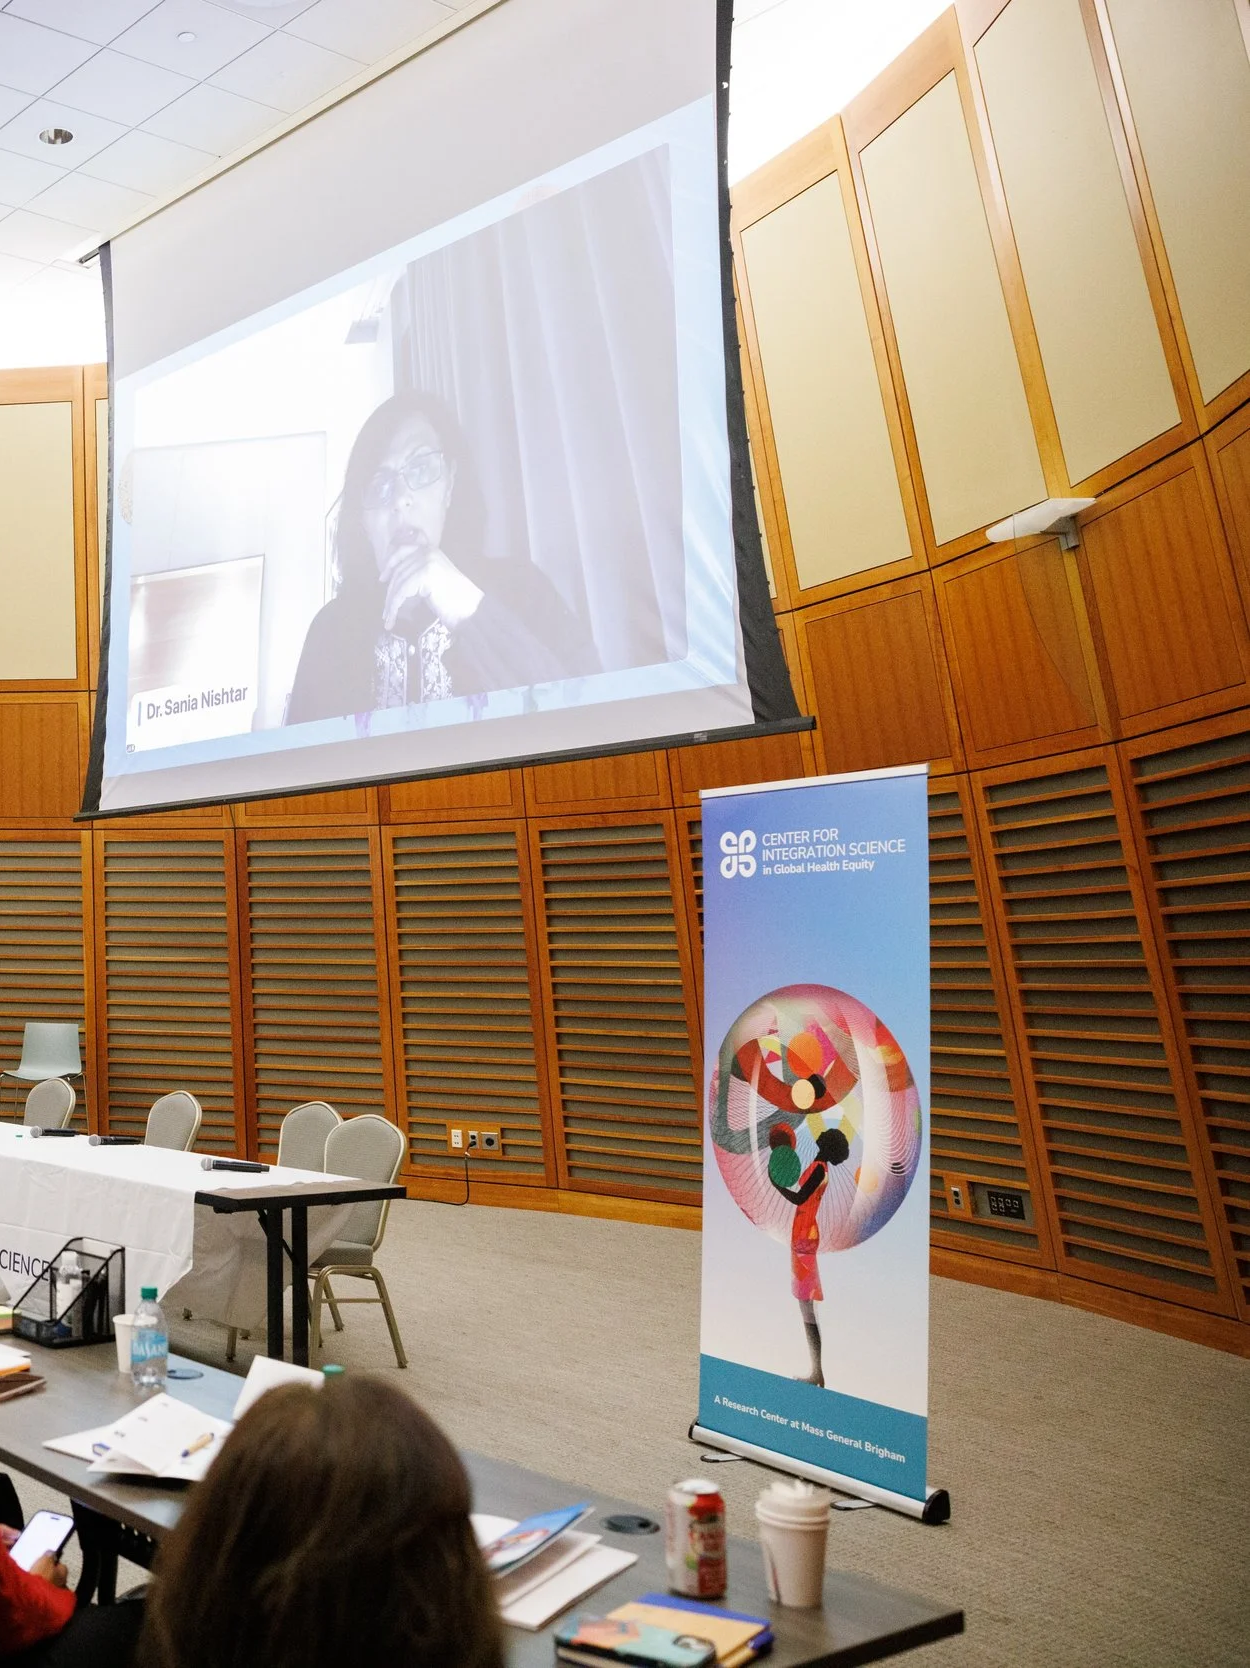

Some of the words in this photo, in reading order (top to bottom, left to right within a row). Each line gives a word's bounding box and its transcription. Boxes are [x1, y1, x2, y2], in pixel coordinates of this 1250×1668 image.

[147, 703, 162, 719] Dr.
[165, 694, 198, 716] Sania
[201, 686, 248, 709] Nishtar
[762, 831, 810, 846] CENTER
[813, 829, 838, 842] FOR
[763, 844, 845, 862] INTEGRATION
[849, 839, 905, 856] SCIENCE
[763, 865, 771, 875] in
[774, 861, 805, 875] Global
[808, 860, 840, 873] Health
[842, 859, 875, 872] Equity
[714, 1395, 721, 1405] A
[723, 1397, 759, 1417] Research
[760, 1409, 788, 1426] Center
[790, 1420, 799, 1430] at
[801, 1422, 824, 1437] Mass
[826, 1430, 862, 1450] General
[865, 1441, 906, 1464] Brigham
